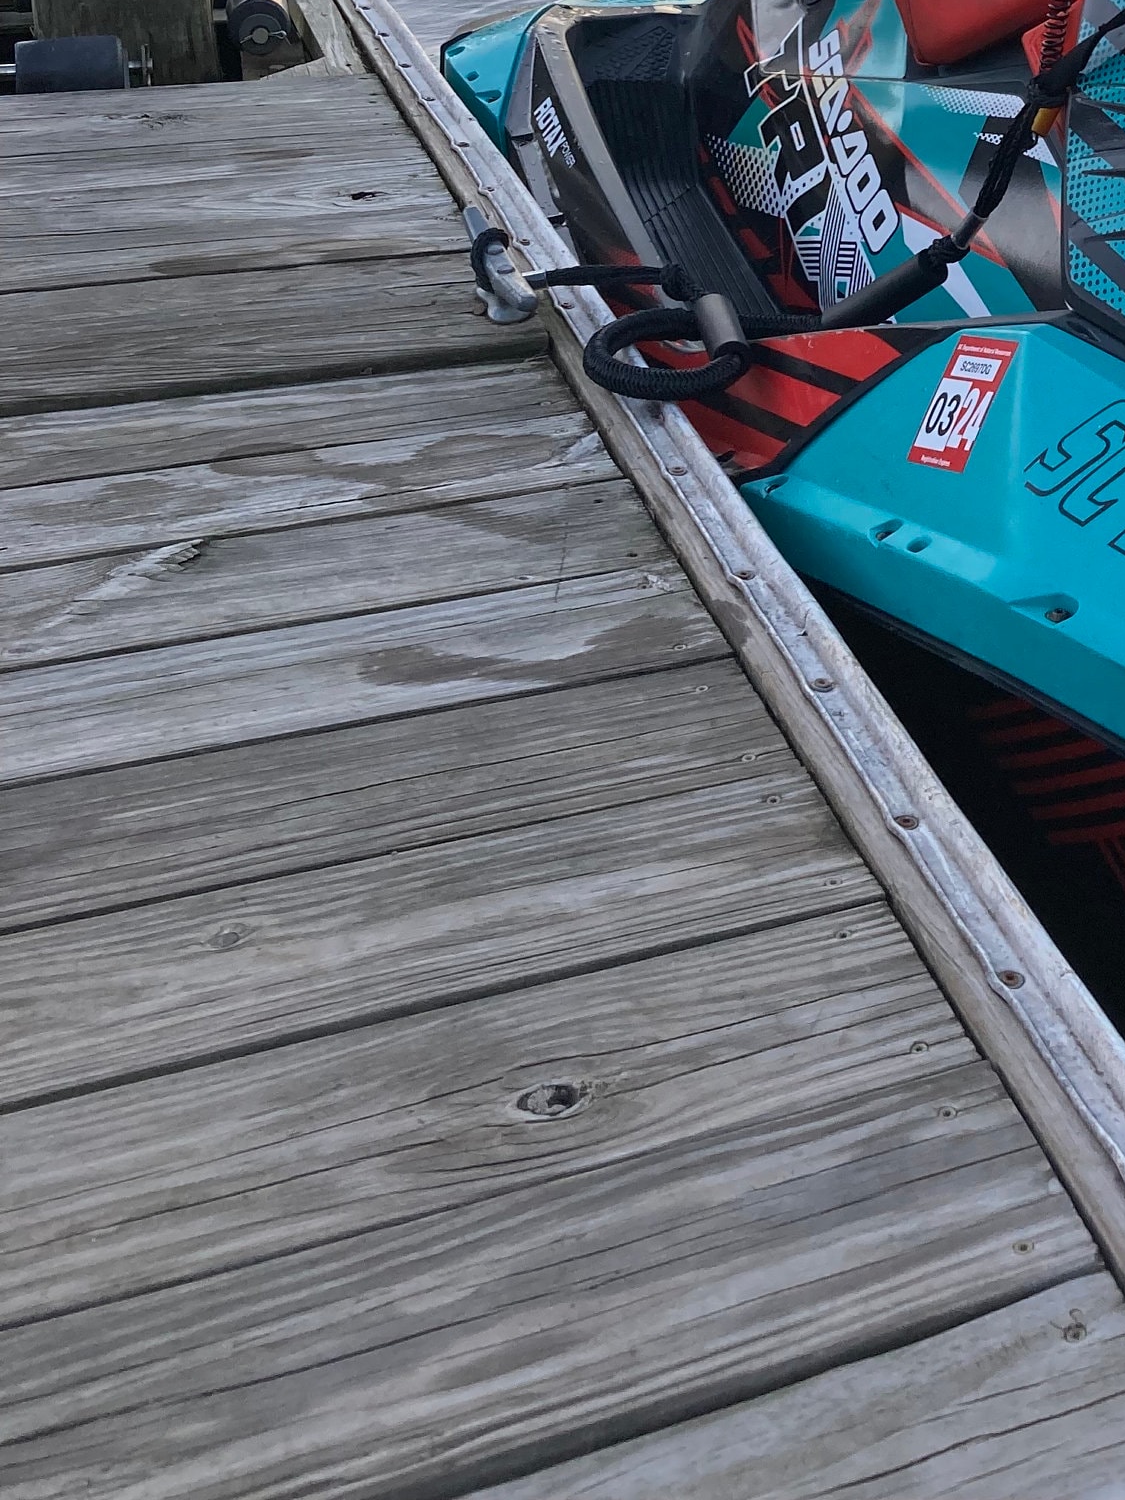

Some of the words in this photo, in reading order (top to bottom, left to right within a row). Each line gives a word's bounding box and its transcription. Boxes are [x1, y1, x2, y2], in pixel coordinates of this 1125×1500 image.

[533, 96, 567, 158] ROTAX
[560, 140, 576, 169] POWER
[925, 392, 961, 437] 03
[945, 387, 995, 451] 24
